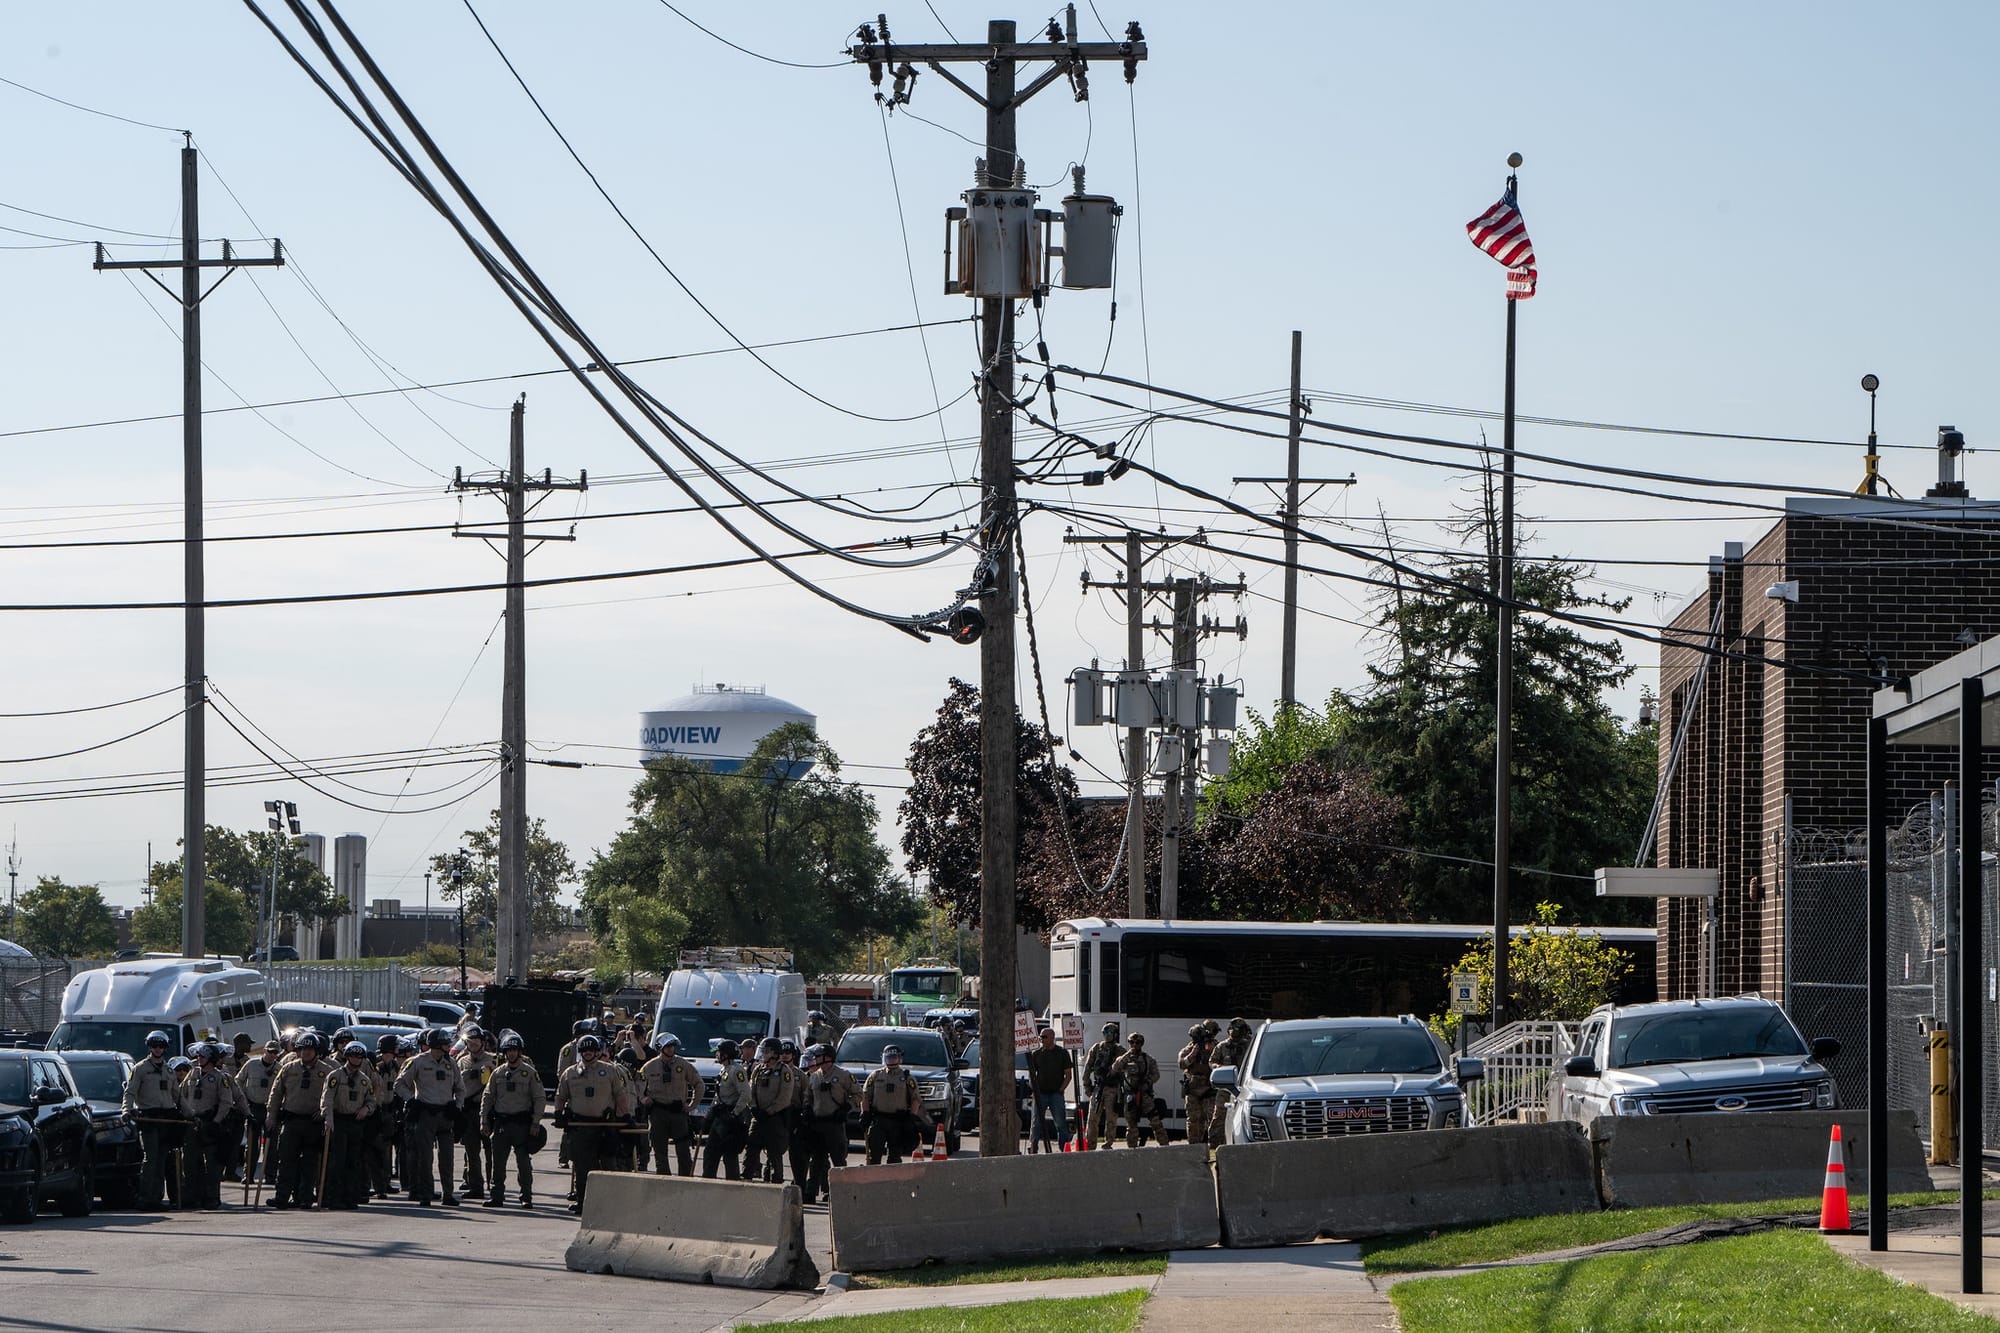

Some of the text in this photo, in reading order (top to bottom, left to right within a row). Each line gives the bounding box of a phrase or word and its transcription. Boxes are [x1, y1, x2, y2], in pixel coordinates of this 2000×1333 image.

[1017, 1018, 1026, 1026] NO
[1015, 1028, 1034, 1037] TRUCK
[1015, 1036, 1039, 1047] PARKING
[1329, 1107, 1386, 1119] GMC
